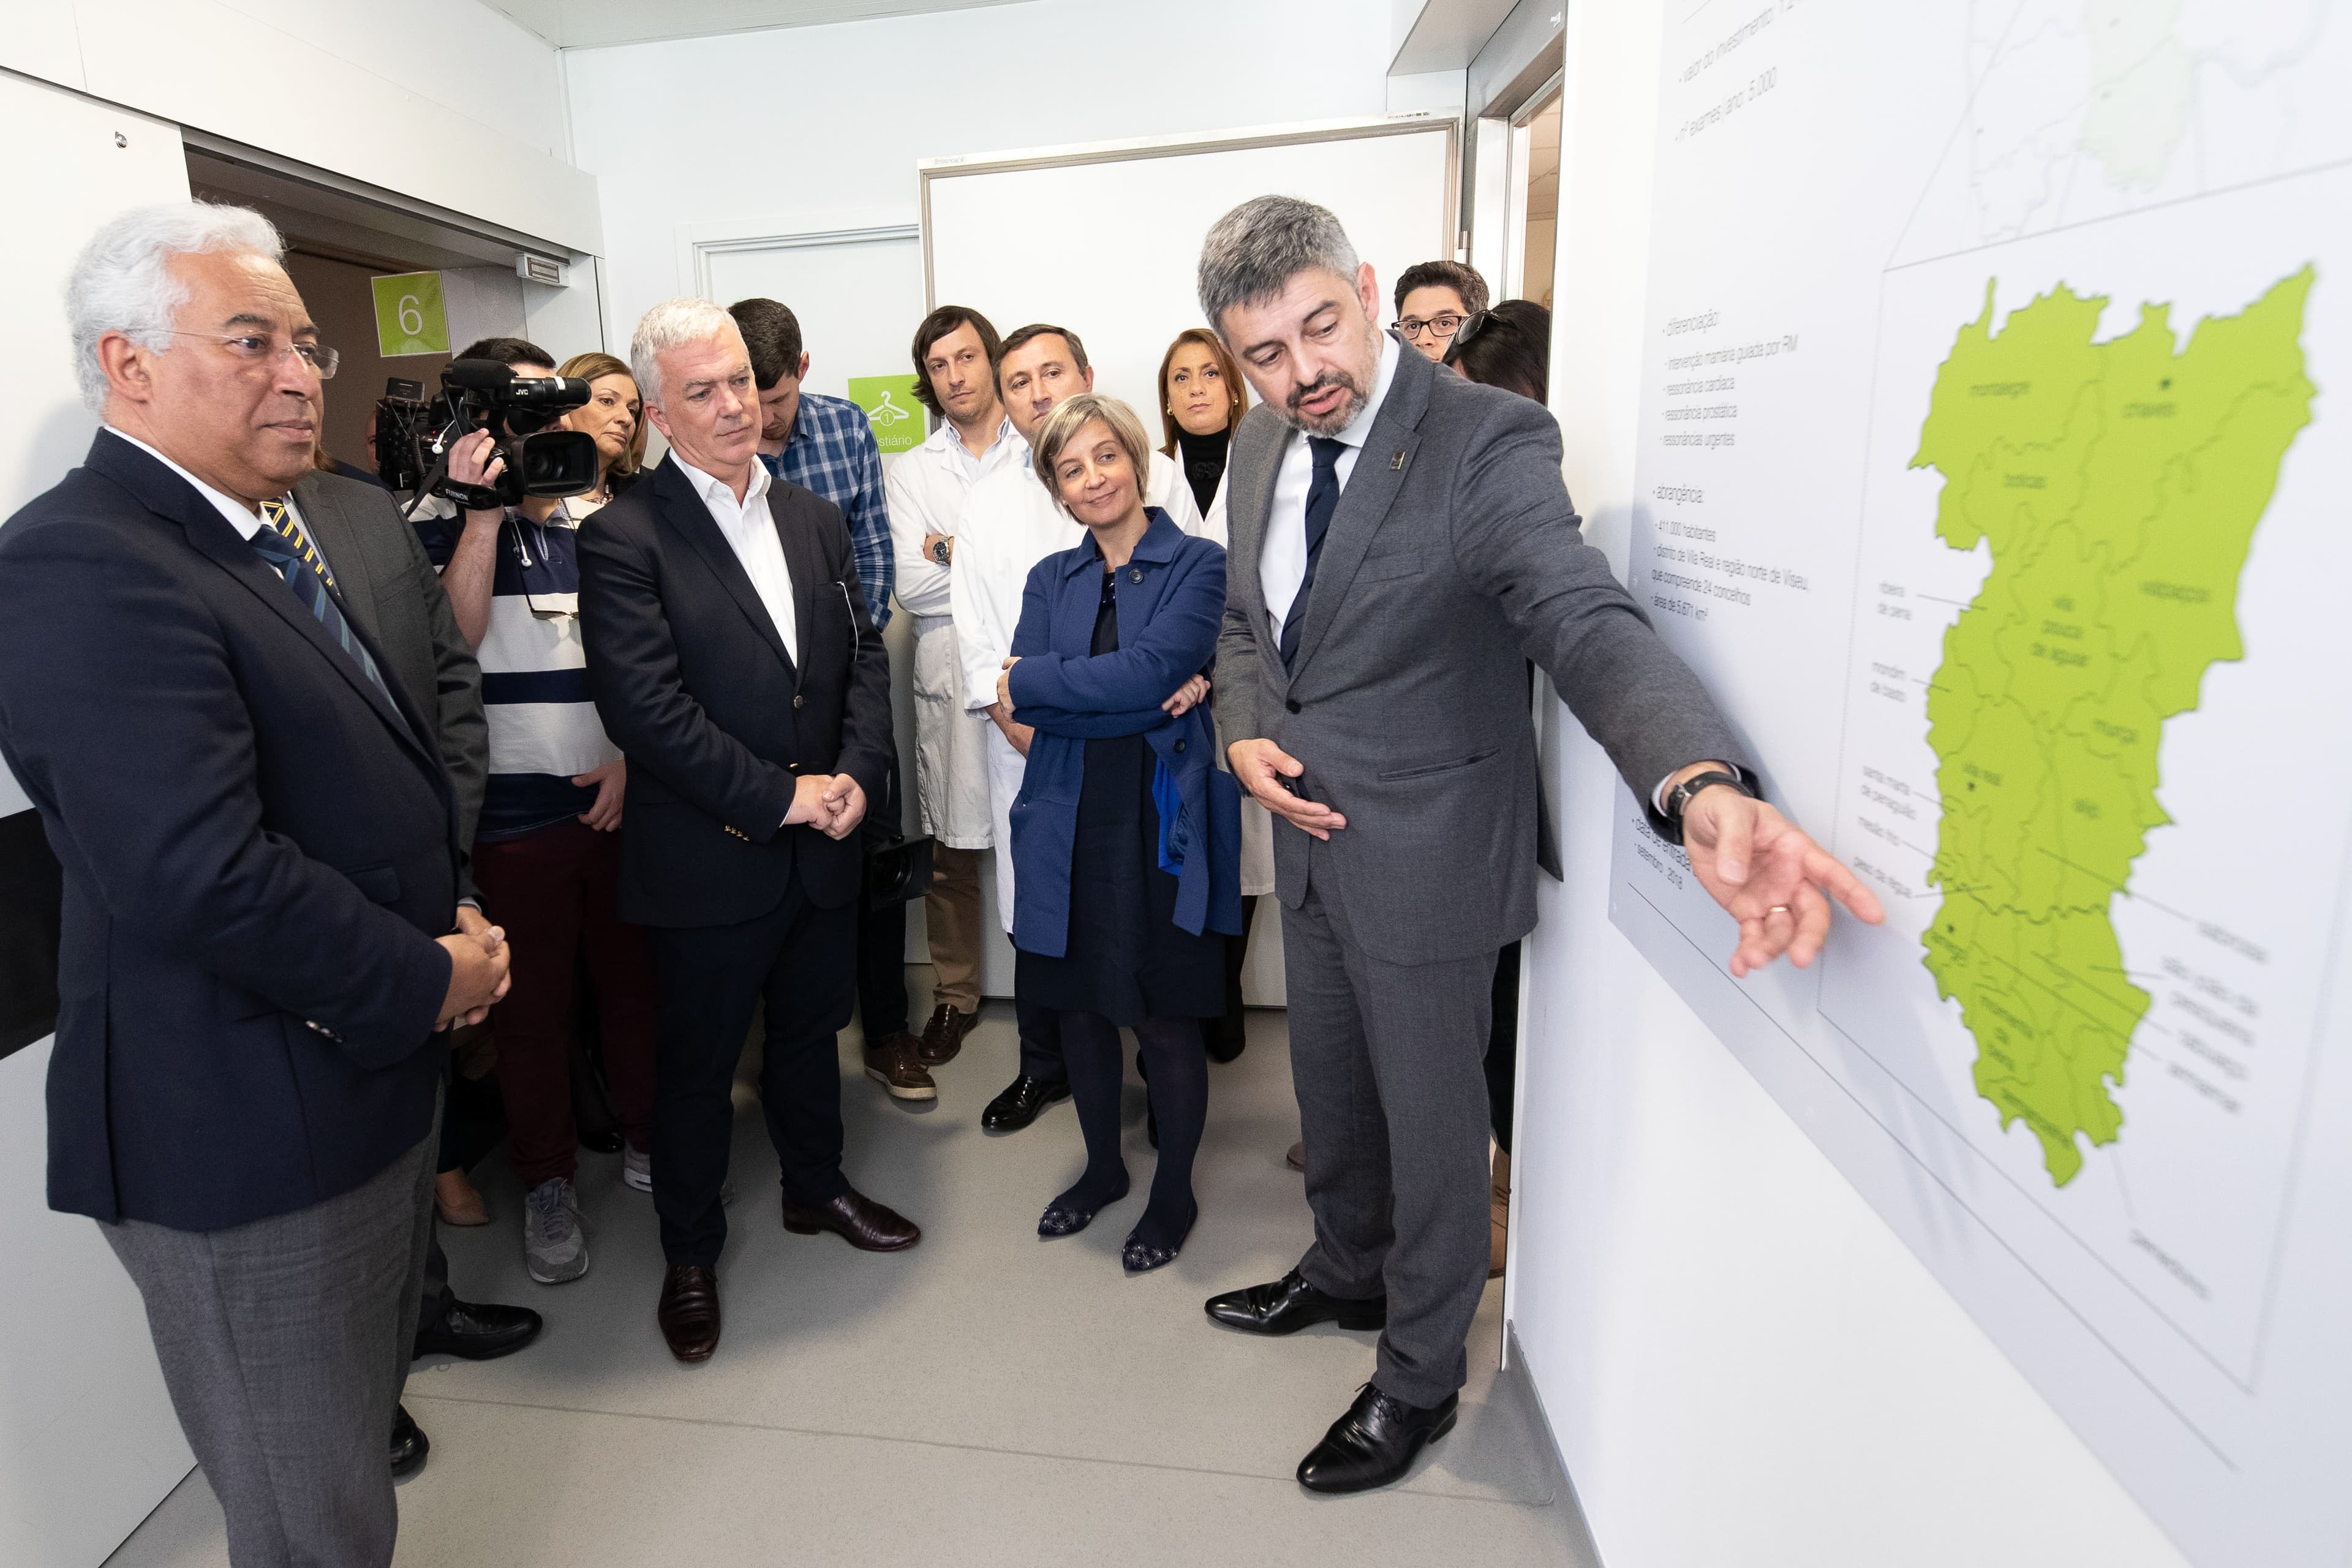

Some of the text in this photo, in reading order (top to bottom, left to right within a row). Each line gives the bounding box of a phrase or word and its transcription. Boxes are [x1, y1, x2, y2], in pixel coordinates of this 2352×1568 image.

[1690, 105, 1721, 137] exames
[1749, 66, 1777, 101] 5.000
[398, 295, 423, 335] 6
[1766, 341, 1781, 360] por
[1782, 334, 1798, 353] RM
[1666, 378, 1703, 396] ressonância
[884, 413, 889, 423] 1
[1665, 405, 1702, 422] ressonância
[878, 435, 912, 447] stiário
[1663, 431, 1703, 447] ressonâncias
[445, 489, 469, 500] FUJINON
[1683, 522, 1716, 543] habitantes
[1656, 545, 1676, 561] distrito
[1678, 548, 1686, 563] de
[1687, 549, 1698, 565] Vila
[1700, 552, 1715, 569] Real
[1722, 559, 1745, 578] região
[1747, 564, 1767, 582] norte
[1770, 566, 1781, 584] de
[1651, 570, 1751, 606] que compreende 24 concelhos
[1668, 598, 1676, 612] de
